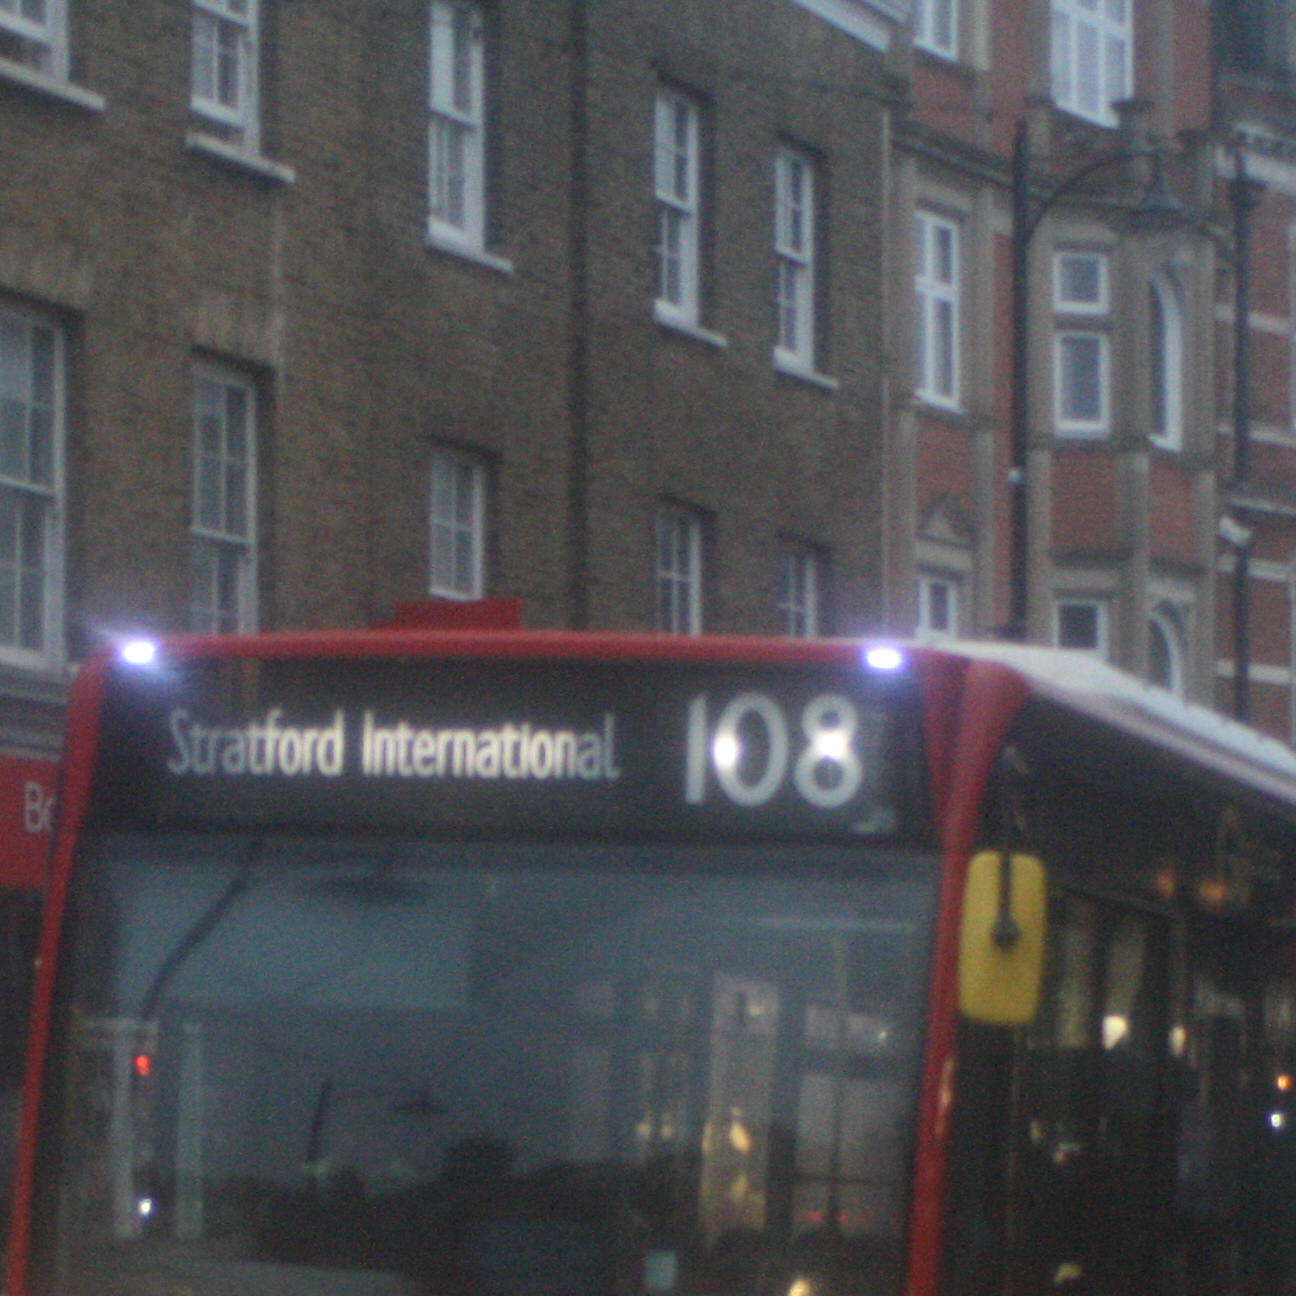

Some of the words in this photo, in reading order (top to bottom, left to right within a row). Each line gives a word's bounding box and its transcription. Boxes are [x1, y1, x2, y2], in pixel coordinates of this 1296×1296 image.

[166, 706, 346, 777] Stratford
[361, 708, 622, 781] International
[685, 690, 863, 807] 108
